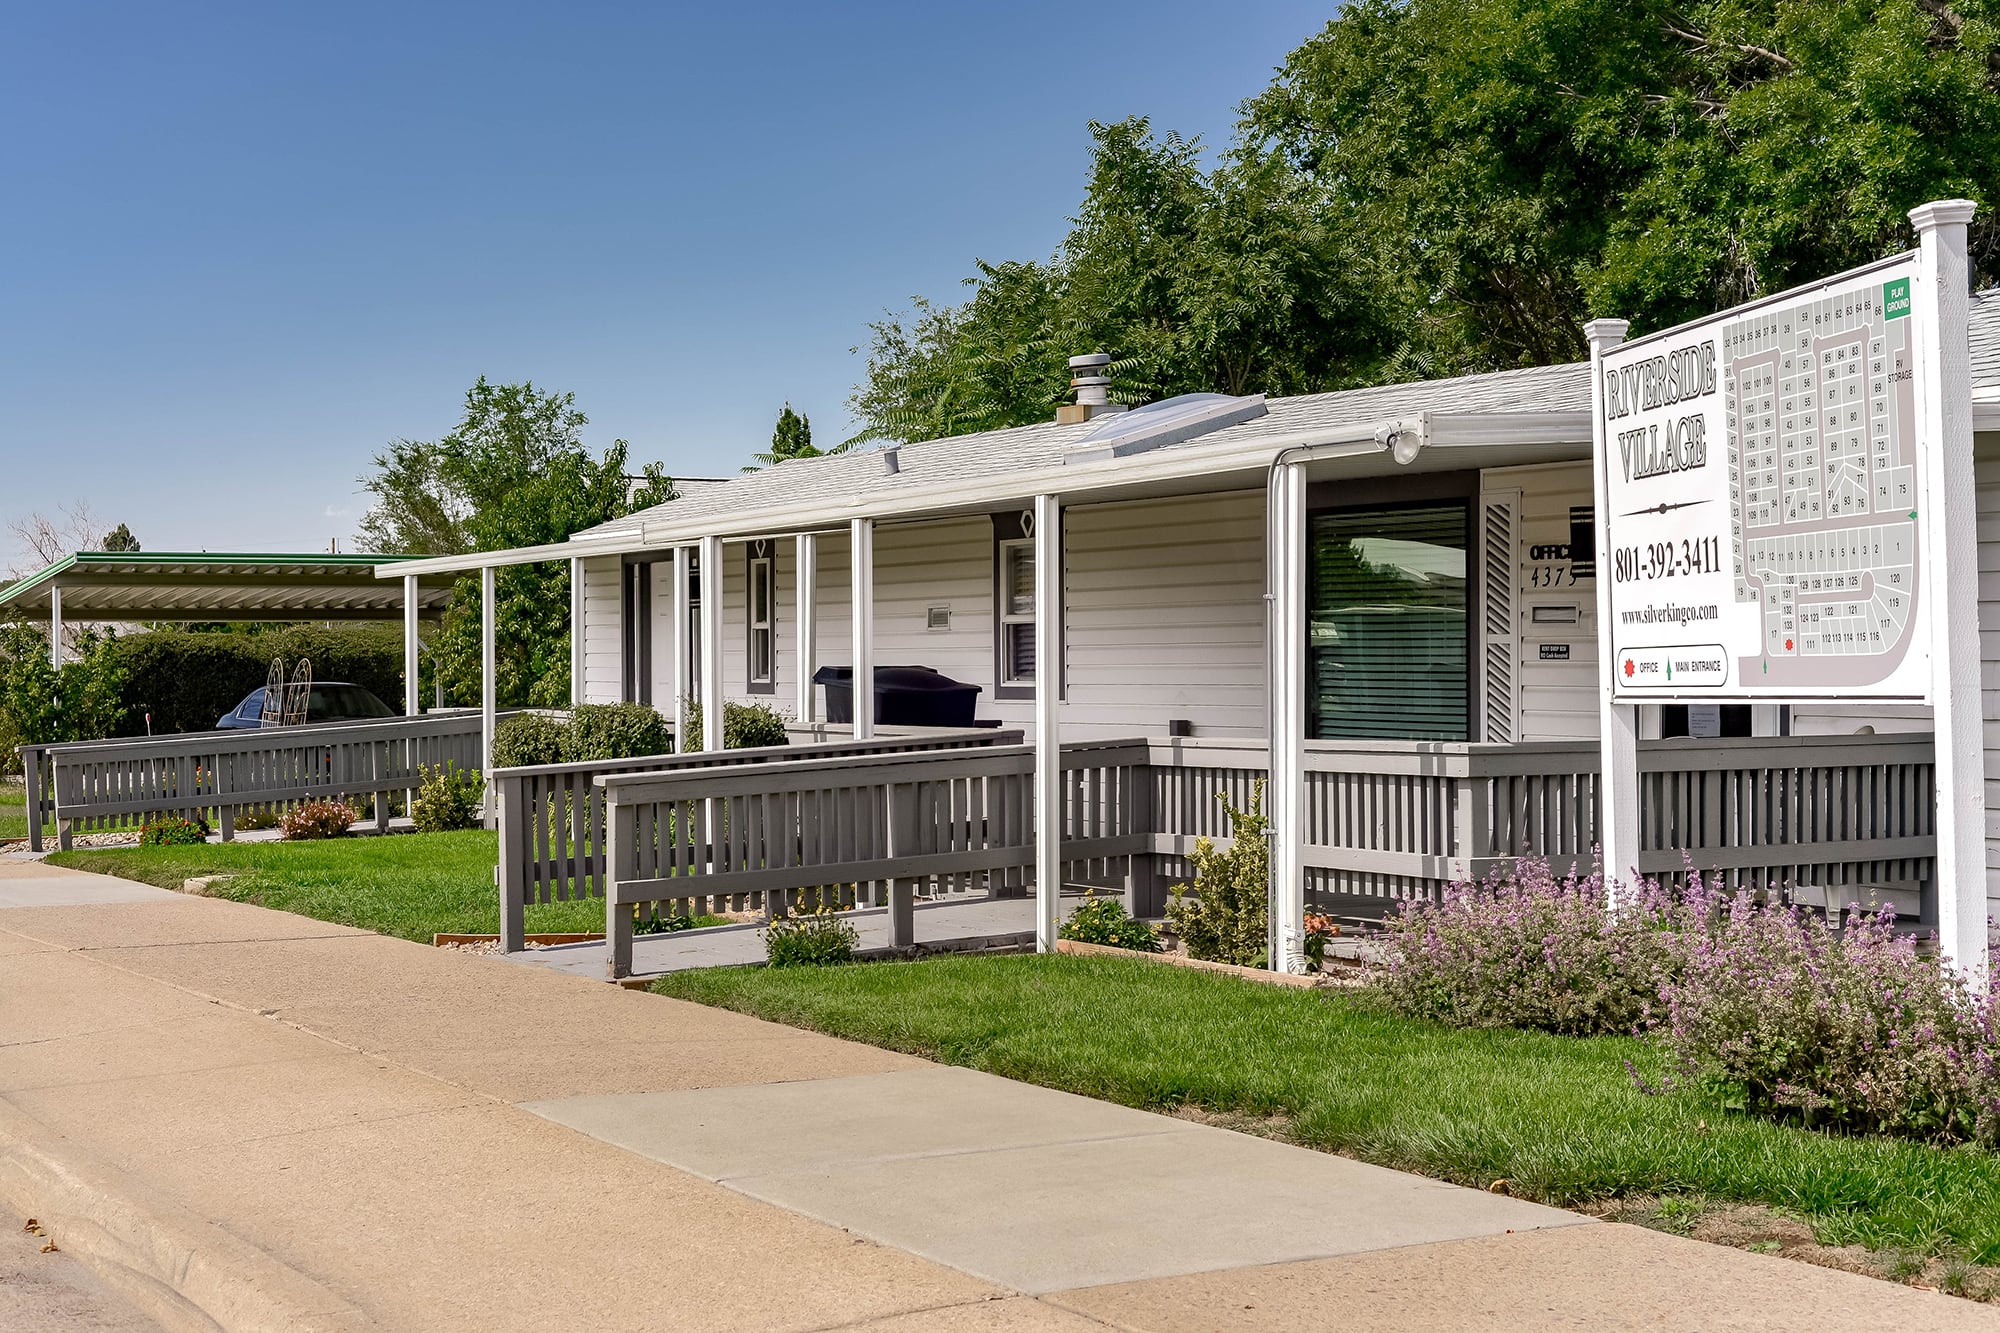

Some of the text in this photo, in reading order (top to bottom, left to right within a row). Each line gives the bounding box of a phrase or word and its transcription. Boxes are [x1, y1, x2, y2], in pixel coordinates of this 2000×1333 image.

[1890, 286, 1905, 299] PLAY
[1886, 298, 1910, 312] GROUND
[1895, 359, 1904, 369] RV
[1606, 340, 1717, 420] RIVERSIDE
[1887, 370, 1912, 383] STORAGE
[1618, 413, 1707, 483] VILLAGE
[1615, 535, 1721, 583] 801-392-3411
[1622, 602, 1718, 627] www.silverkingco.com
[1639, 662, 1659, 673] OFFICE
[1675, 660, 1721, 673] MAIN ENTRANCE
